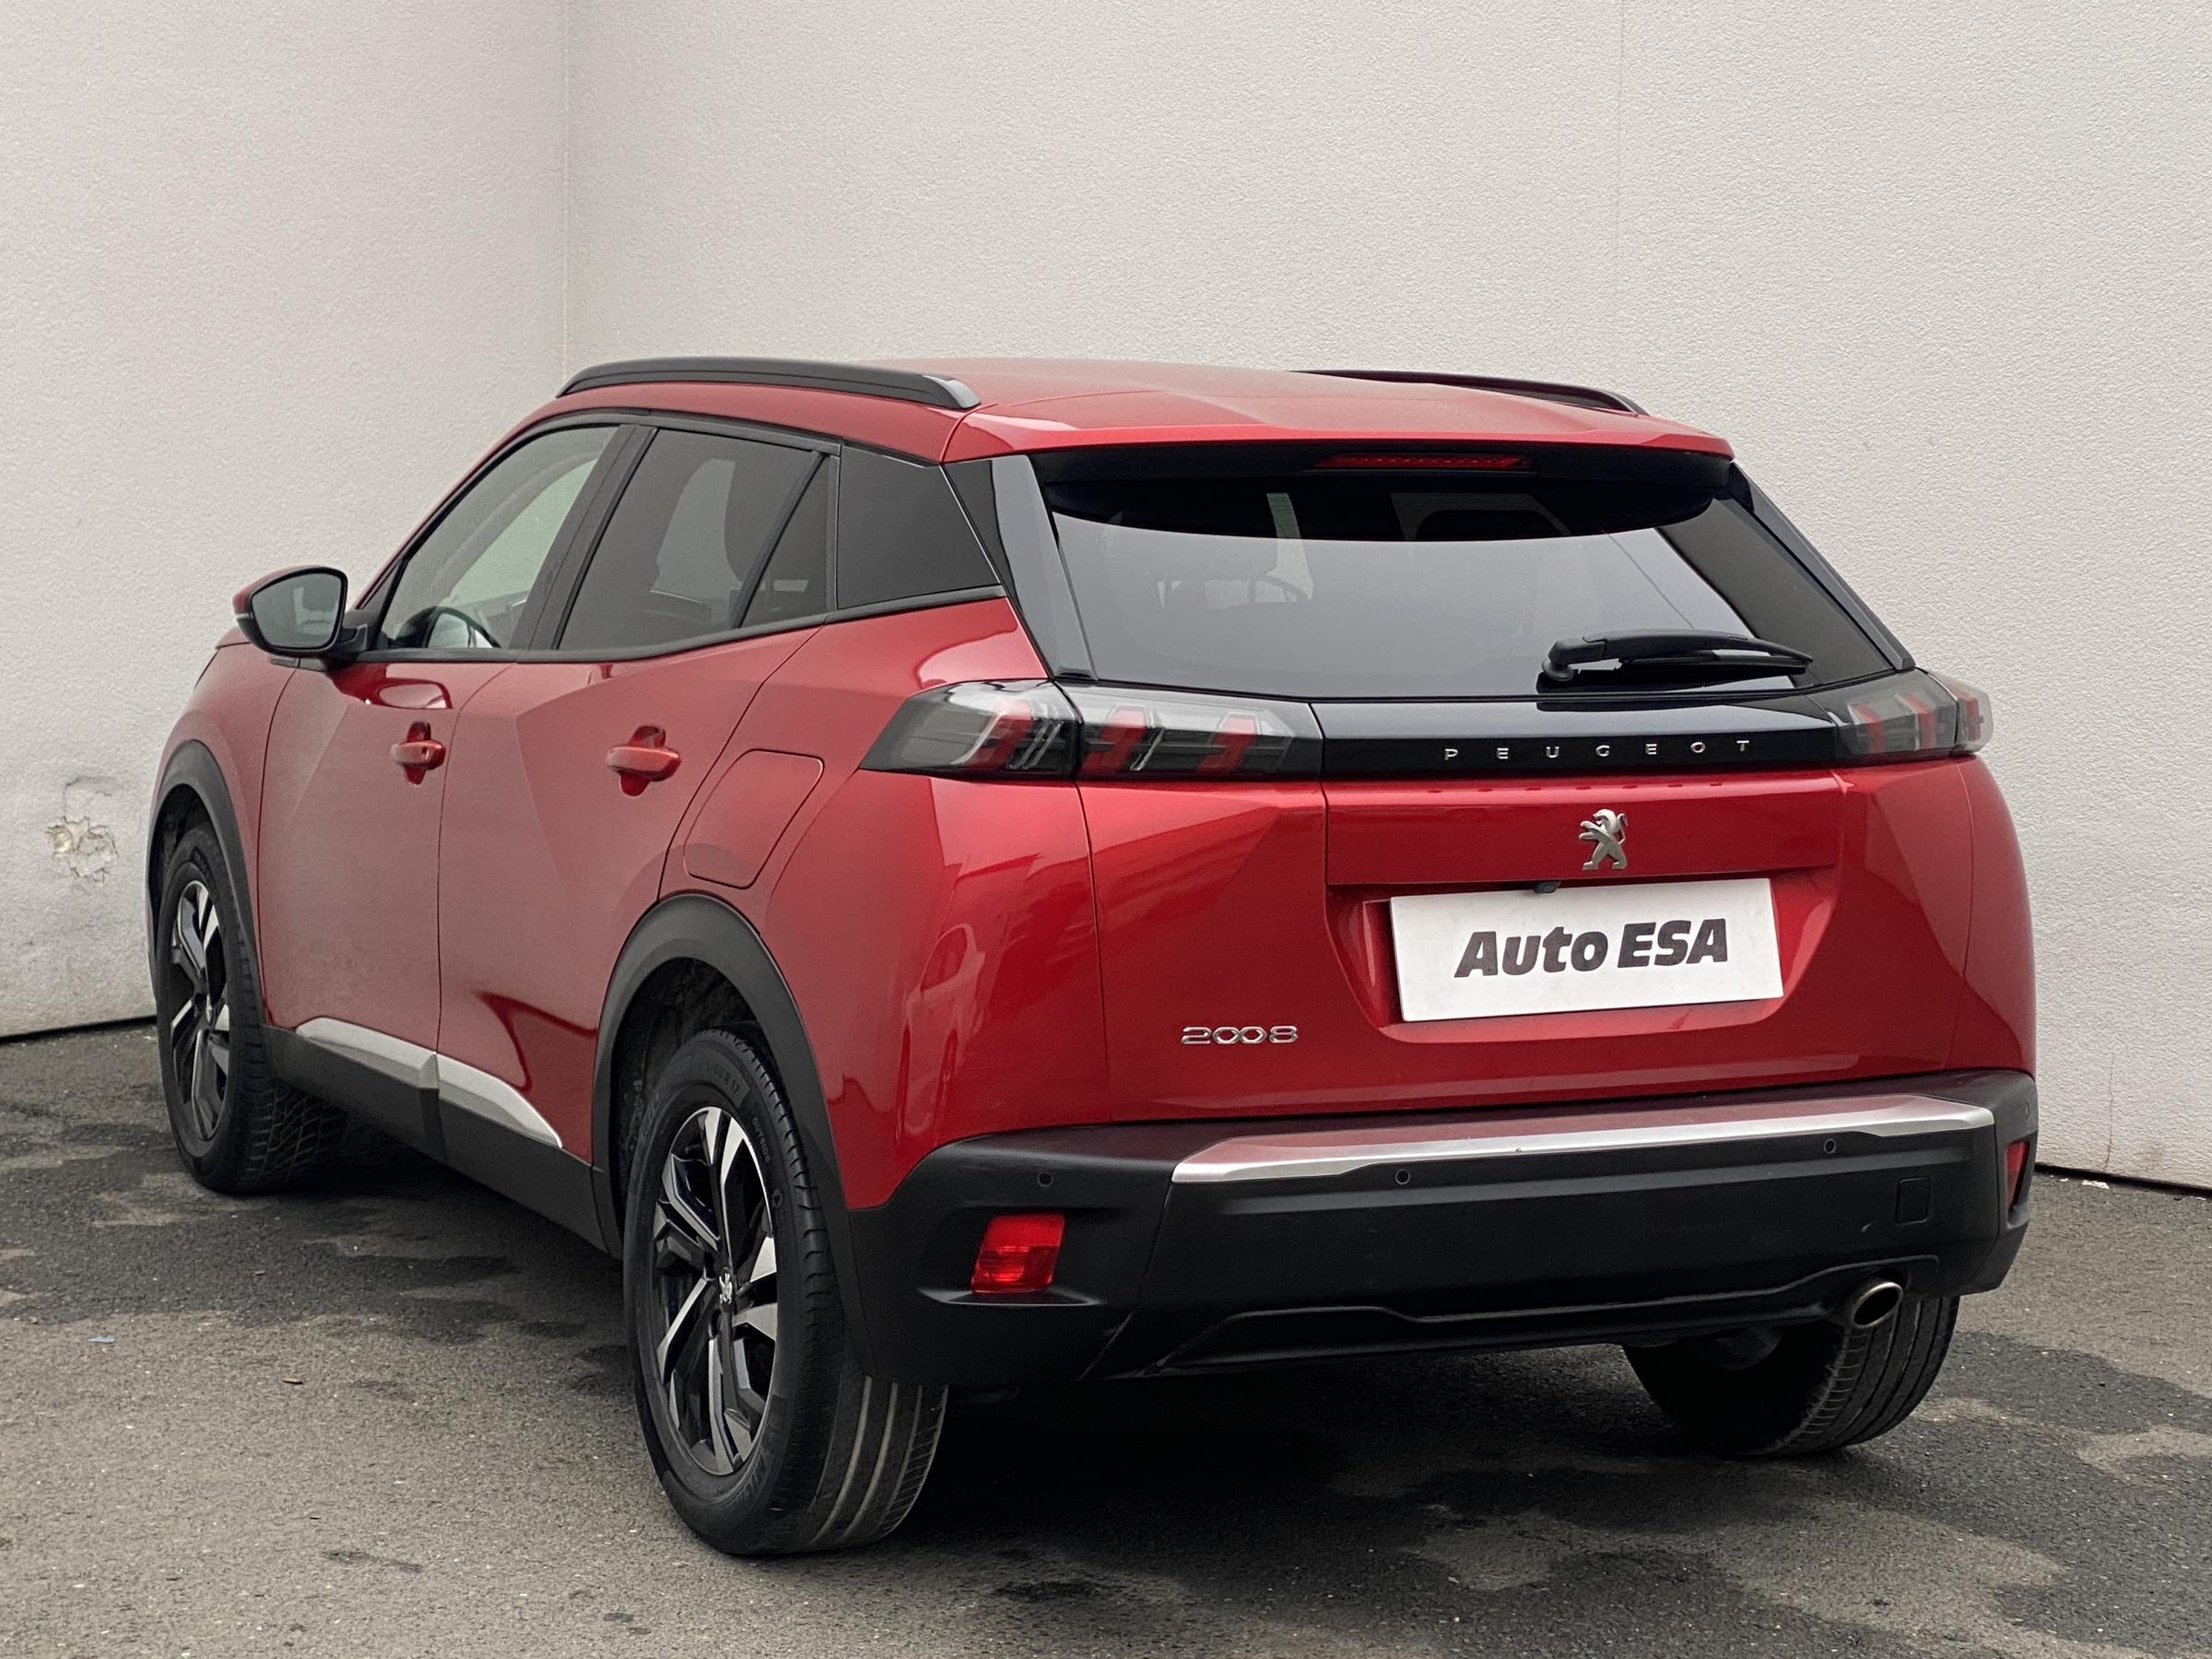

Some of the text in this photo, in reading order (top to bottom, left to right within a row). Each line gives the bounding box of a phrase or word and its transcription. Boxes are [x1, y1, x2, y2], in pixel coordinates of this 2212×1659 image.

[1443, 739, 1750, 760] PEUGEOT
[1453, 918, 1729, 979] Auto ESA
[1181, 1025, 1299, 1045] 2008
